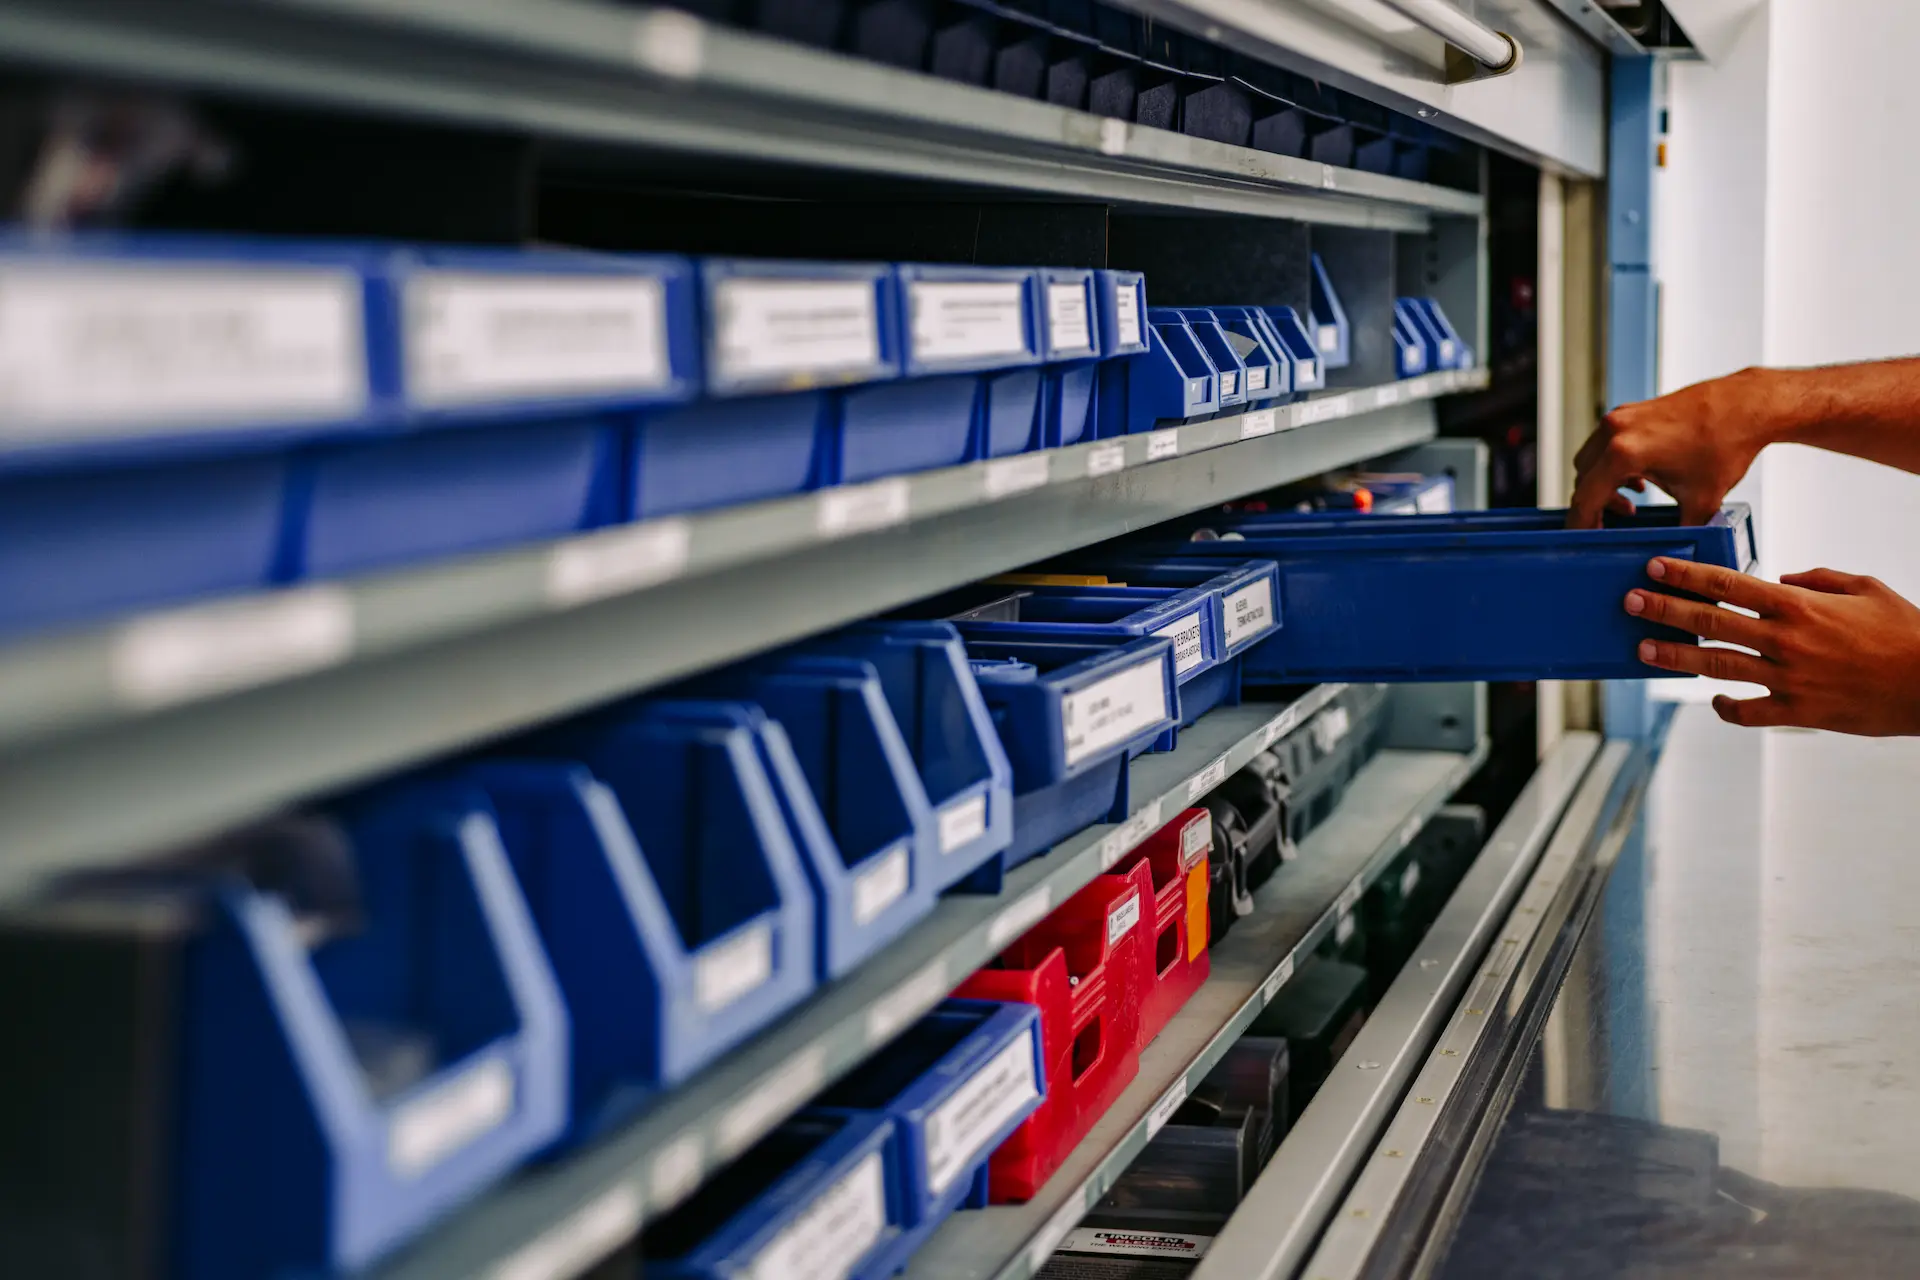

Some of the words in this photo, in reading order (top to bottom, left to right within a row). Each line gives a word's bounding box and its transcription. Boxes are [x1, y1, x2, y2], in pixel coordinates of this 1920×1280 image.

[1180, 624, 1200, 645] BRACKETS
[1100, 1233, 1180, 1243] LINCOLN
[1115, 1239, 1186, 1248] ELECTRIC
